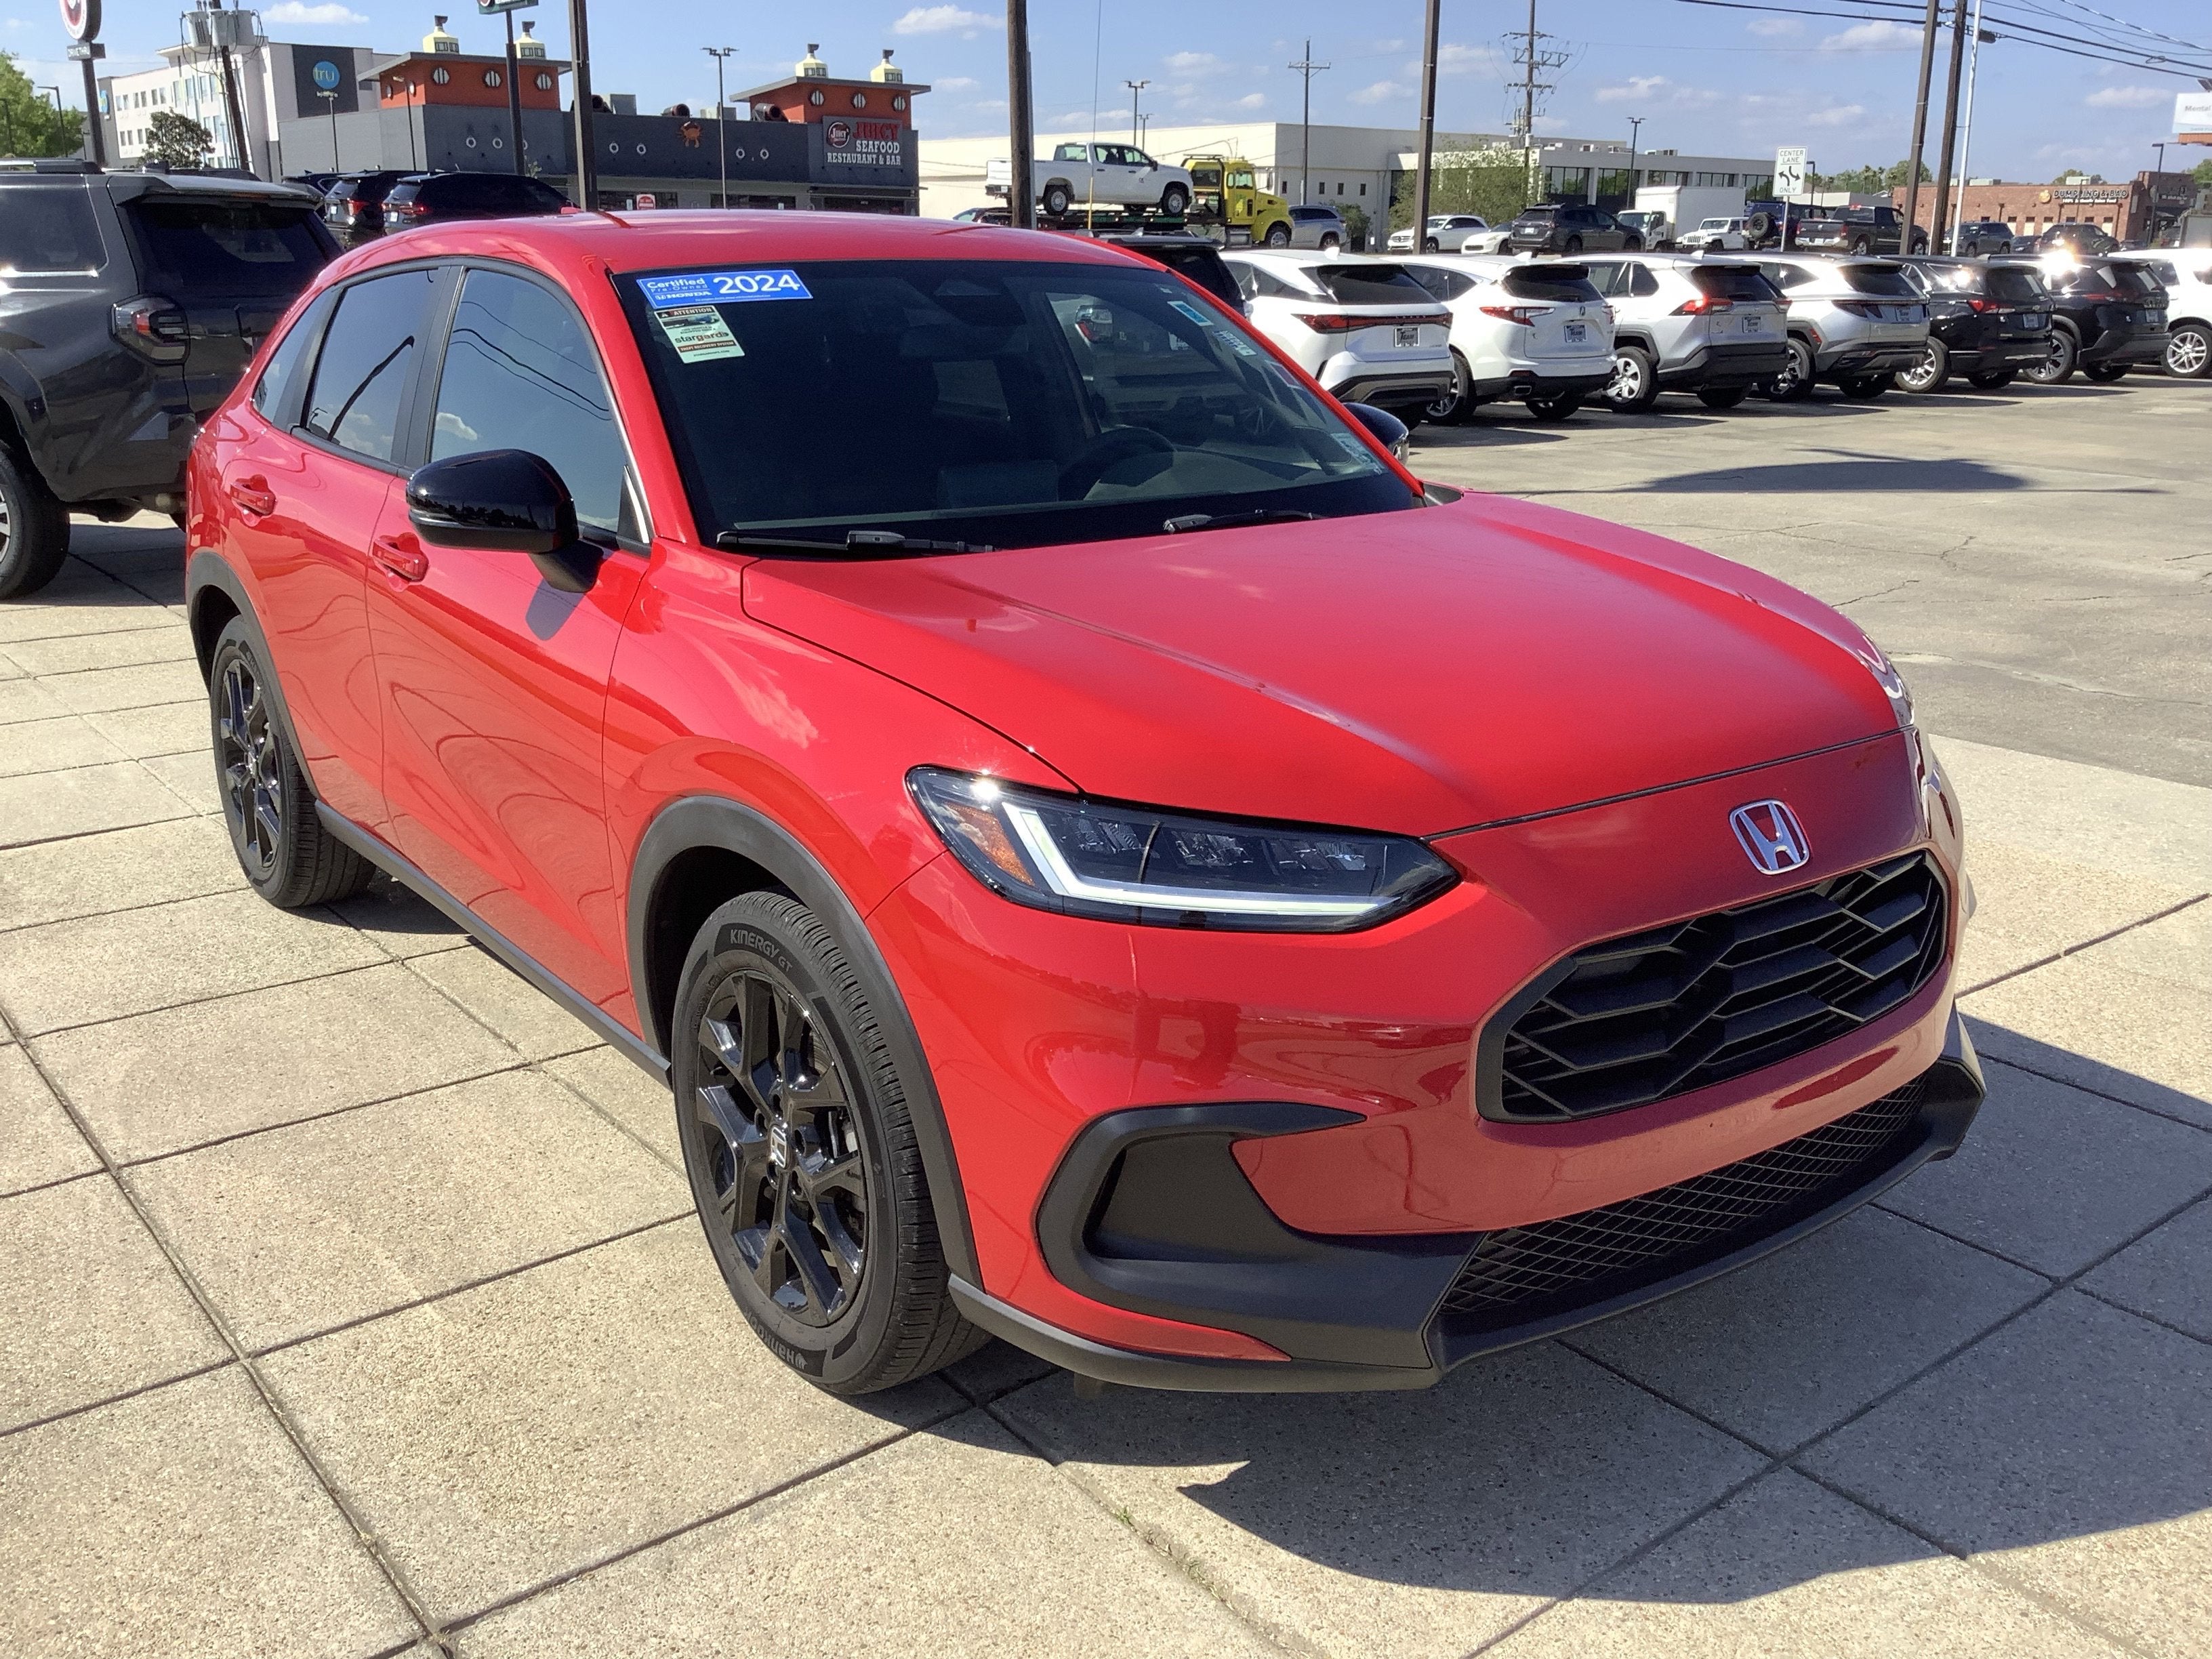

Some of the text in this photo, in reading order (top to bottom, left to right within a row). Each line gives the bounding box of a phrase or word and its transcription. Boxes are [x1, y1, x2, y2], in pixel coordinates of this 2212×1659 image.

[314, 68, 335, 81] tru
[853, 121, 901, 141] JUICY
[856, 140, 900, 154] SEAFOOD
[827, 152, 901, 166] RESTAURANT & BAR
[2110, 190, 2128, 198] BAO
[647, 277, 705, 289] Certified
[651, 285, 708, 293] Pre-Owned
[713, 274, 800, 294] 2024
[665, 291, 712, 299] HONDA
[674, 307, 712, 316] ATTENTION
[731, 929, 793, 972] KINERGY GT
